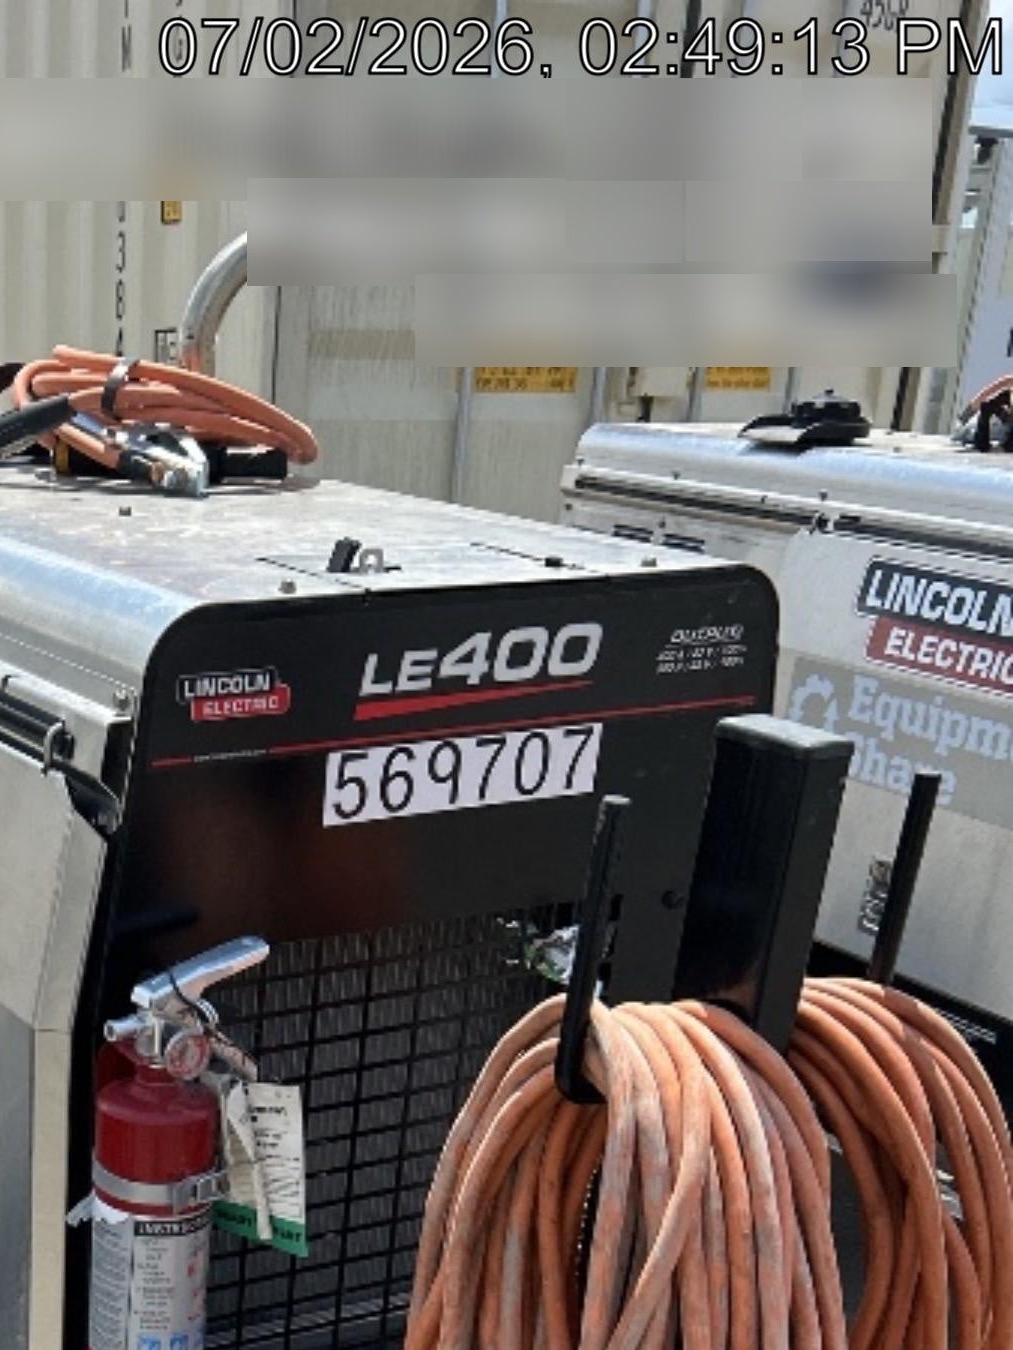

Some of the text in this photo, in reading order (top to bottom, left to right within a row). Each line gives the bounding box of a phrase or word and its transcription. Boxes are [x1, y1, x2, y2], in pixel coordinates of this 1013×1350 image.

[184, 673, 270, 699] LINCOLN
[359, 622, 604, 696] LE400
[203, 695, 280, 716] ELECTRIC
[848, 673, 1013, 764] Equipm
[333, 725, 596, 821] 569707
